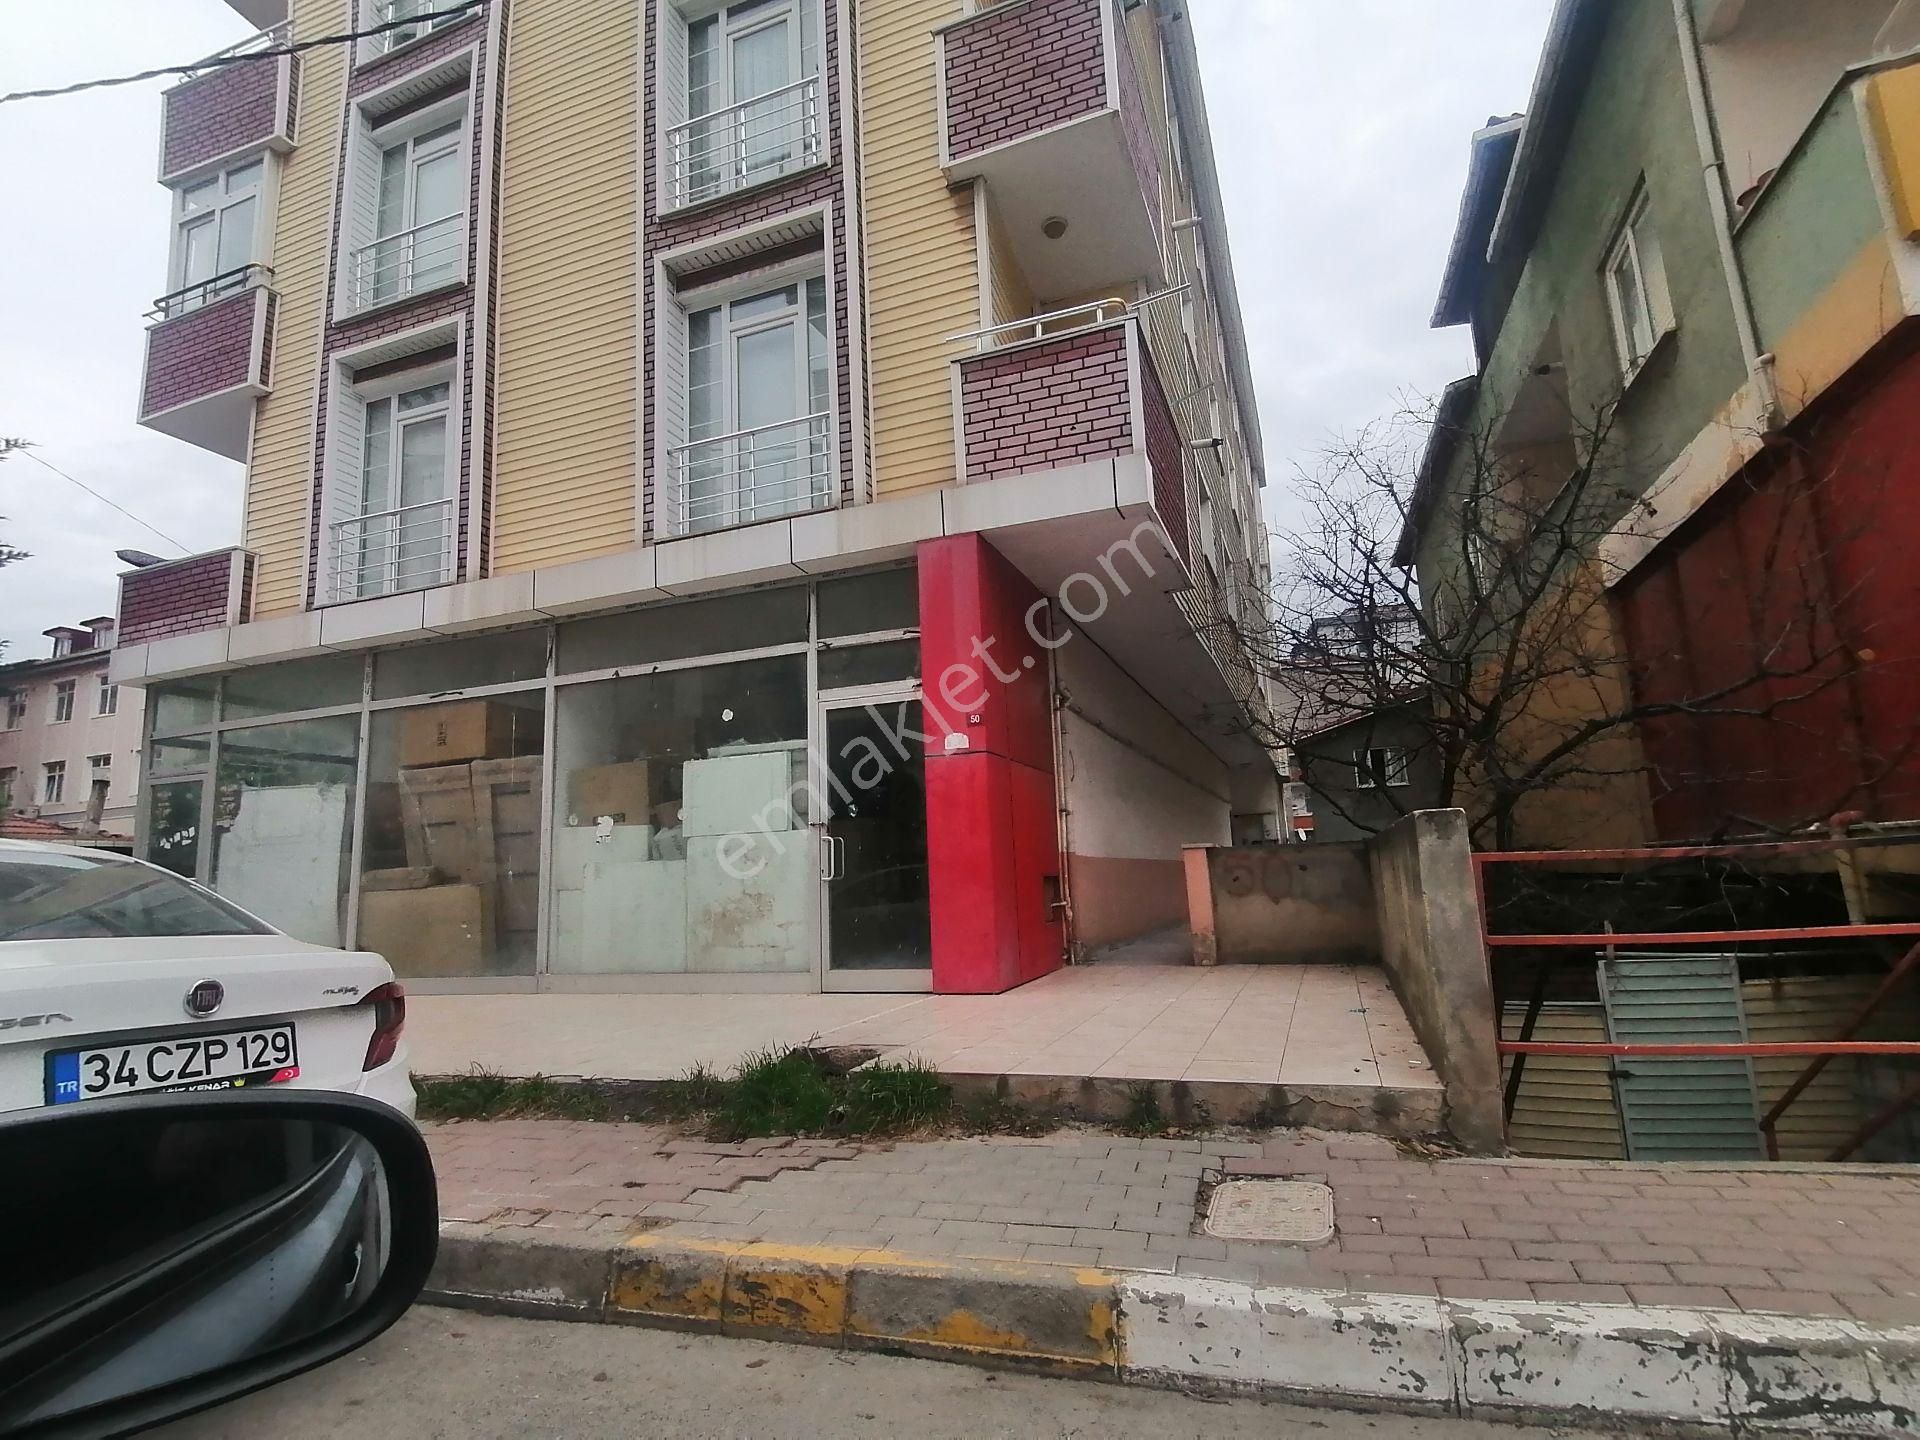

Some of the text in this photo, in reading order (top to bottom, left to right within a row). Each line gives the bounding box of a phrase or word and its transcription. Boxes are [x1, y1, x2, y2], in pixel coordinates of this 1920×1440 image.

[970, 714, 981, 724] 50
[1223, 852, 1293, 899] 50
[83, 1031, 291, 1093] 34 CZP 129
[57, 1080, 78, 1094] TR
